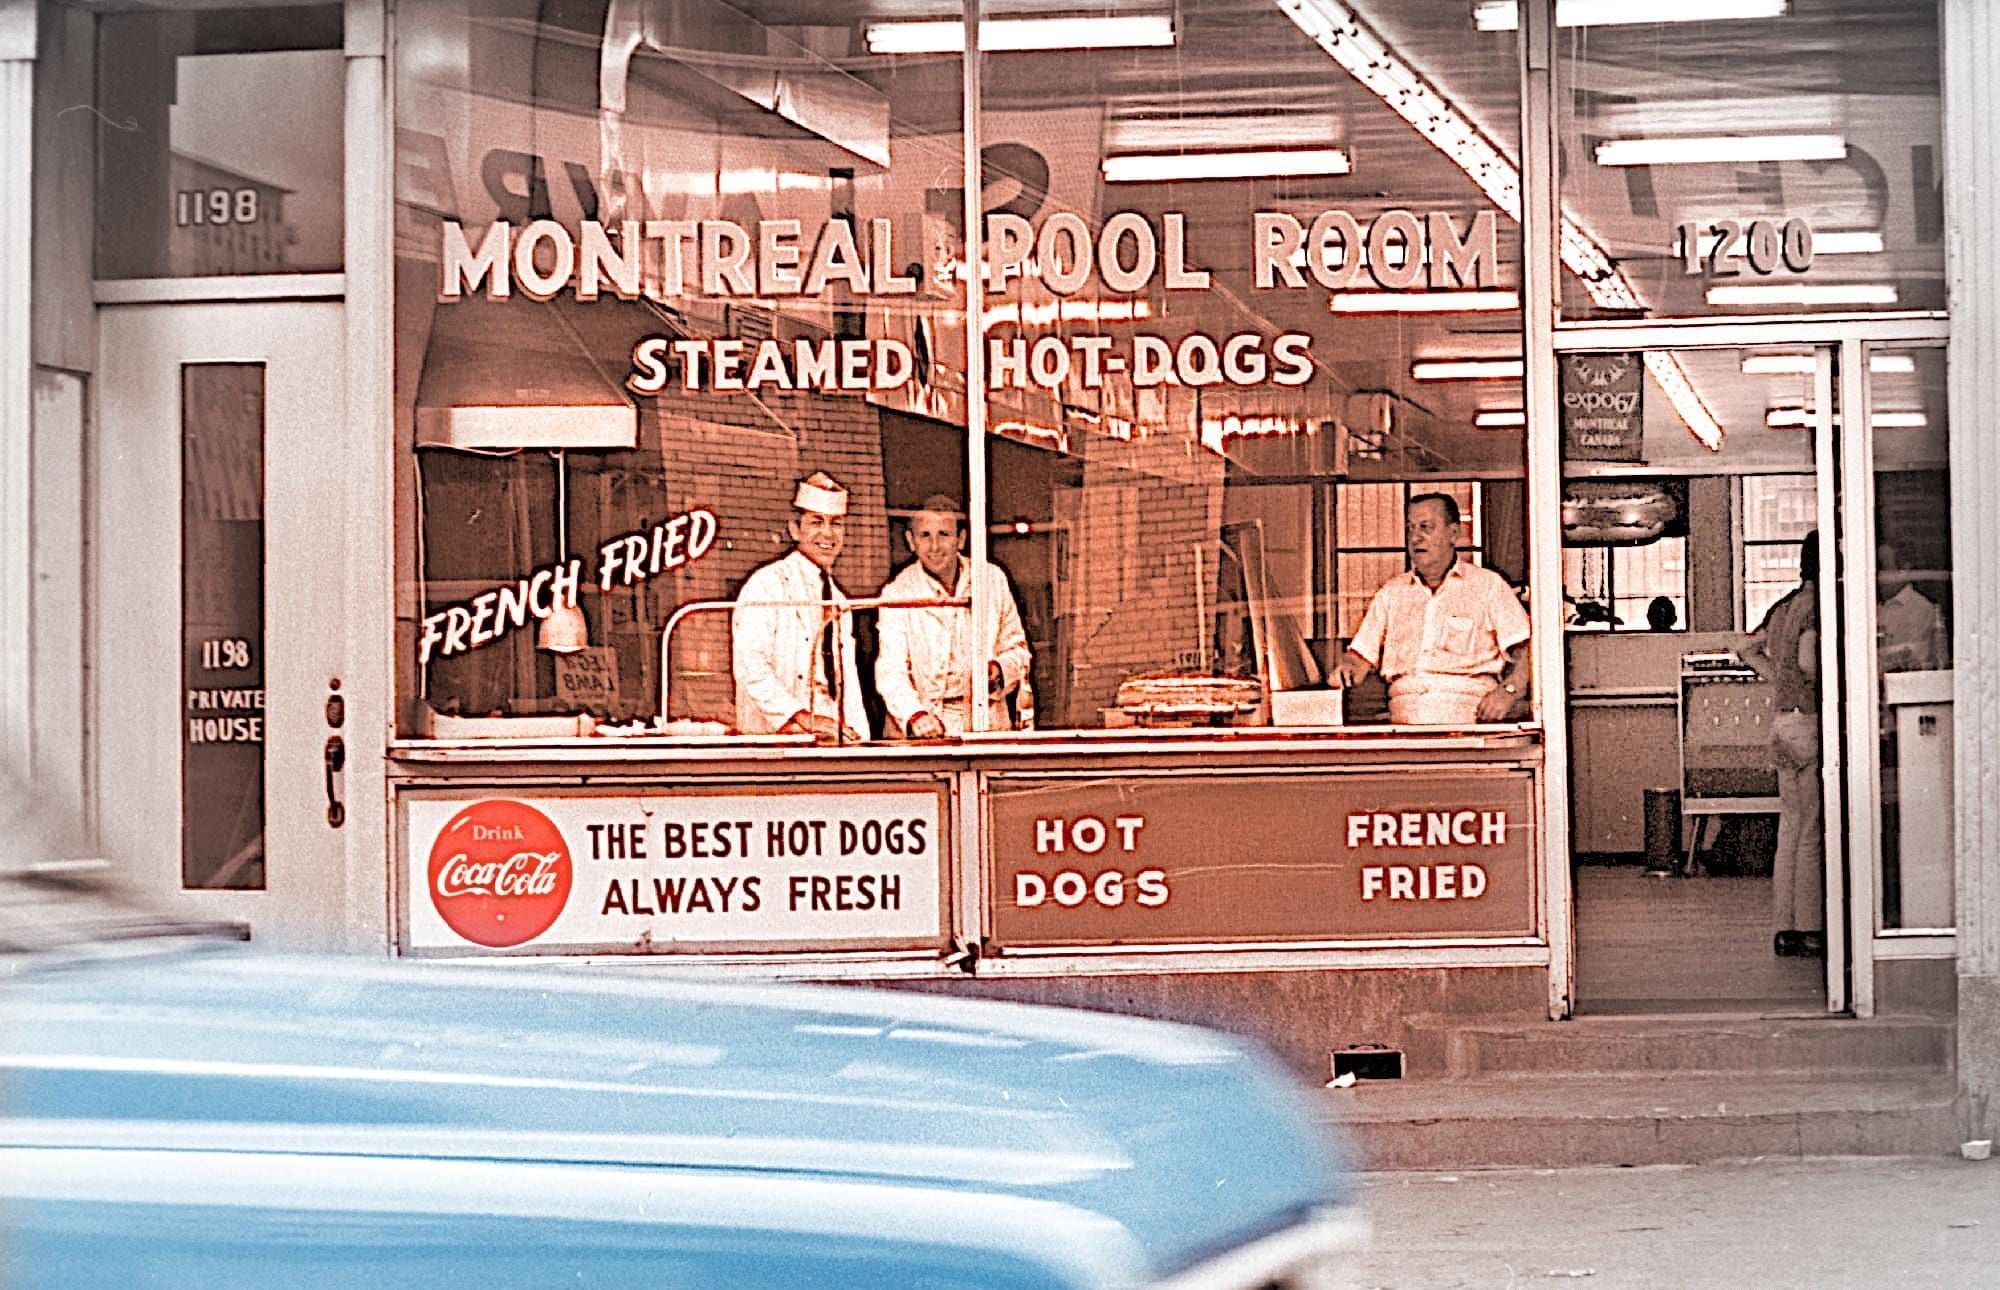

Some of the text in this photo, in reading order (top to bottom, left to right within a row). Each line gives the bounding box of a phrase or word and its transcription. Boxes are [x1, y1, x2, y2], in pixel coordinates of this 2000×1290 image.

[176, 188, 258, 227] 1198
[440, 218, 918, 302] MONTREAL
[986, 209, 1212, 296] POOL
[1254, 208, 1500, 291] ROOM
[1679, 217, 1814, 275] 1200
[628, 332, 1315, 394] STEAMED HOT-DOGS
[418, 508, 721, 666] FRENCH FRIED
[202, 640, 250, 669] 1198
[187, 689, 265, 710] PRIVATE
[189, 716, 264, 743] HOUSE
[472, 824, 526, 842] Drink
[587, 819, 927, 860] THE BEST HOT DOGS
[1034, 816, 1144, 854] HOT
[1346, 811, 1507, 849] FRENCH
[601, 874, 901, 915] ALWAYS FRESH
[1015, 870, 1171, 908] DOGS
[1361, 865, 1490, 901] FRIED
